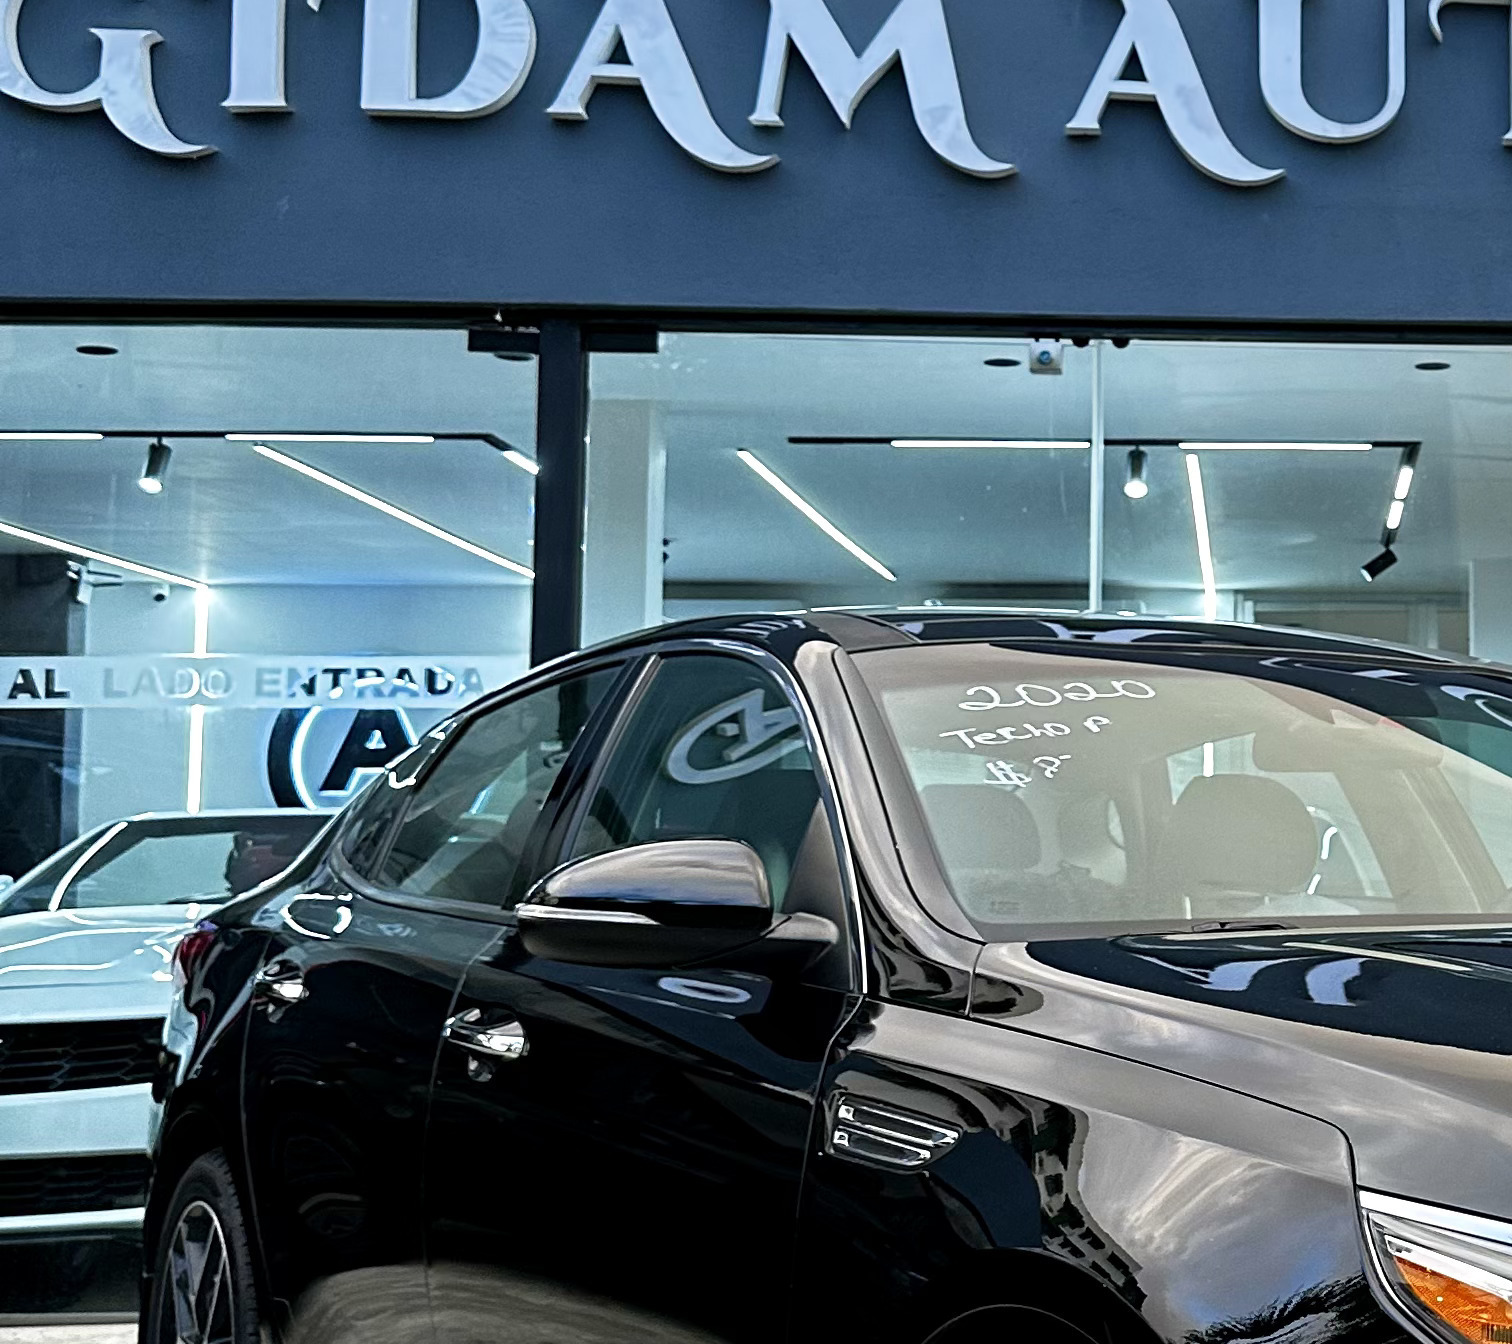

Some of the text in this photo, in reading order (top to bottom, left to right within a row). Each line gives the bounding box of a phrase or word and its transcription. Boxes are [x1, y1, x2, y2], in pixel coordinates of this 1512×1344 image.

[7, 666, 485, 700] AL LADO ENTRADA
[958, 679, 1157, 711] 2020
